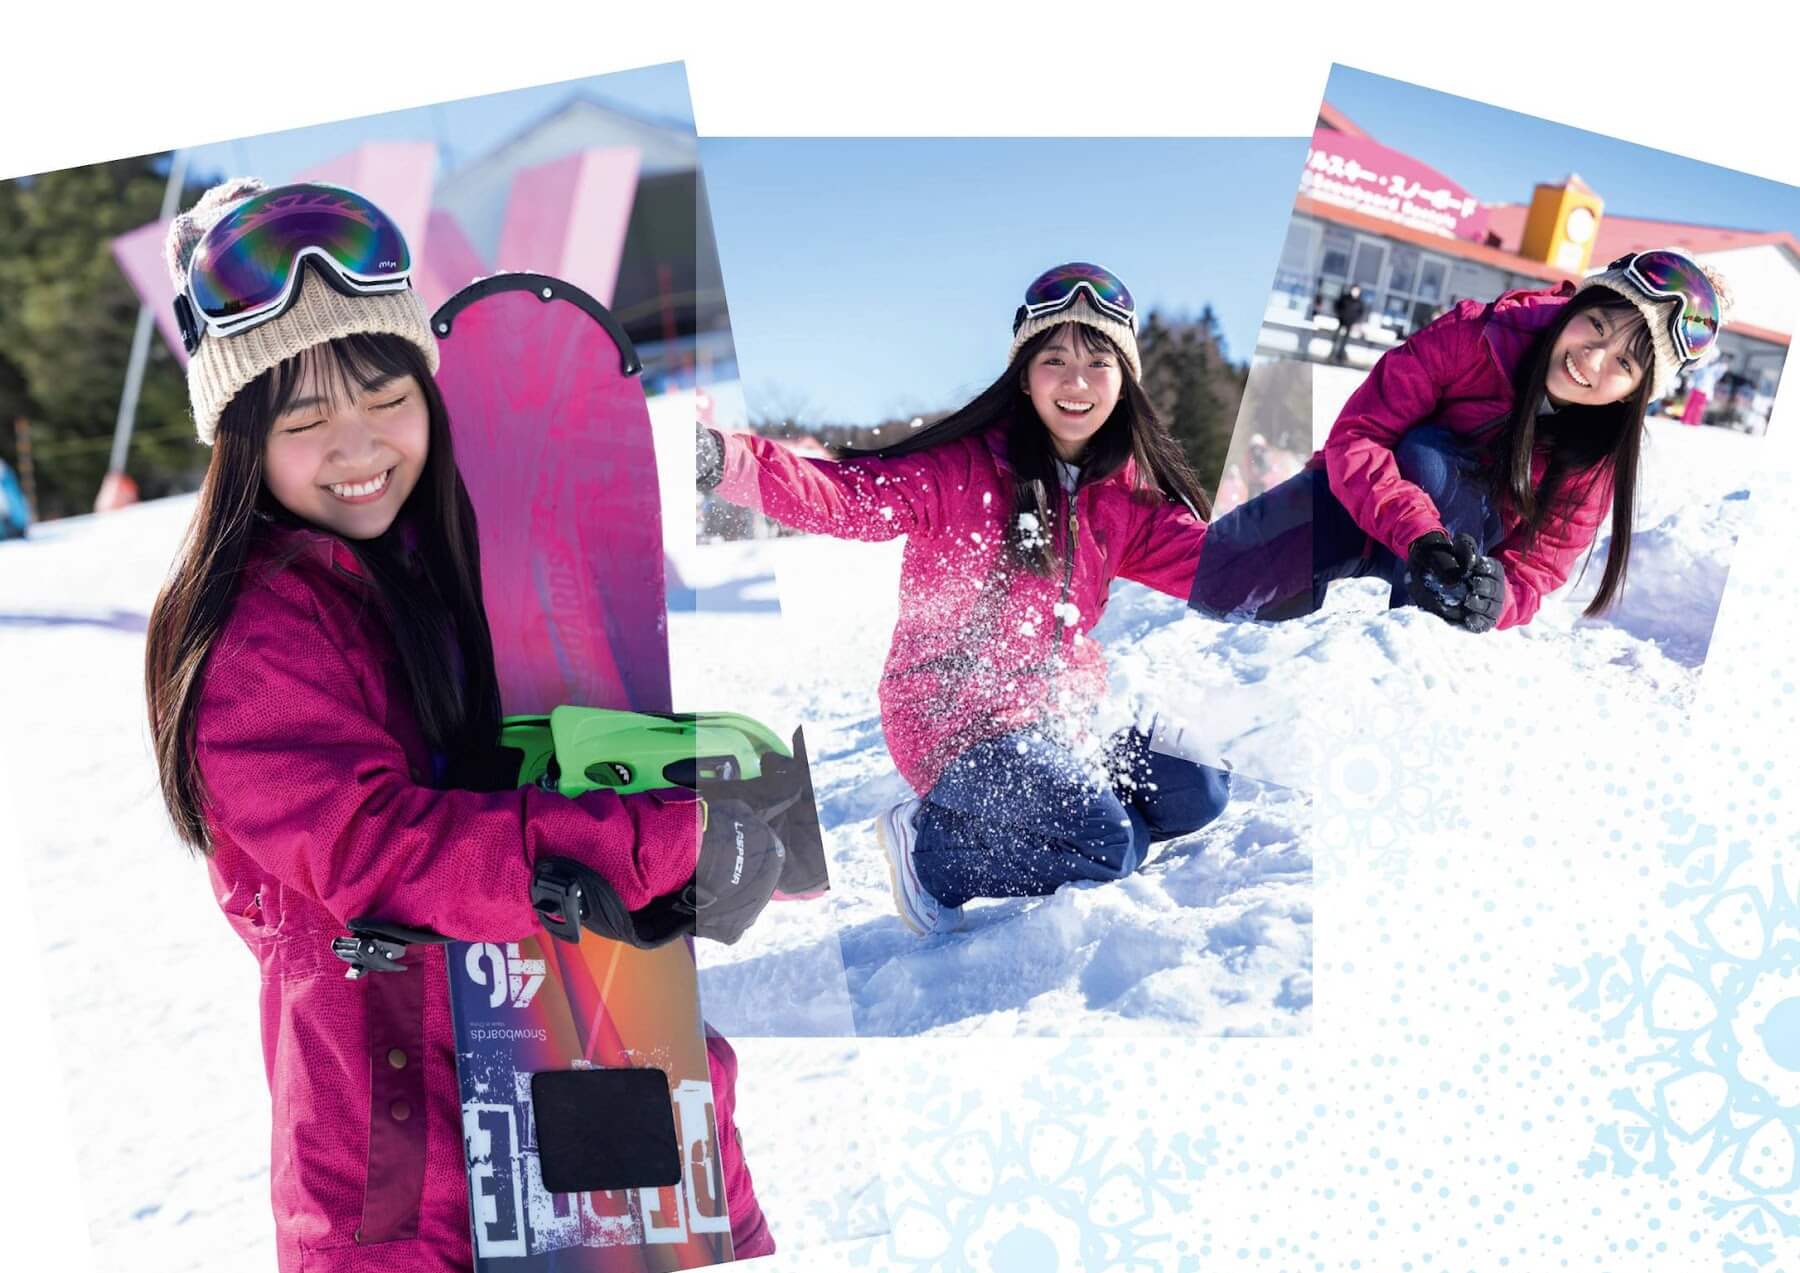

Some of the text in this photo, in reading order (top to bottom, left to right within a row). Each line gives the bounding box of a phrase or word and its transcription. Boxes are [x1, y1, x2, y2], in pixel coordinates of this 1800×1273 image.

[1305, 148, 1477, 218] ルスキー・スノーボード
[465, 943, 546, 1009] 46
[470, 1028, 547, 1042] Snowboards
